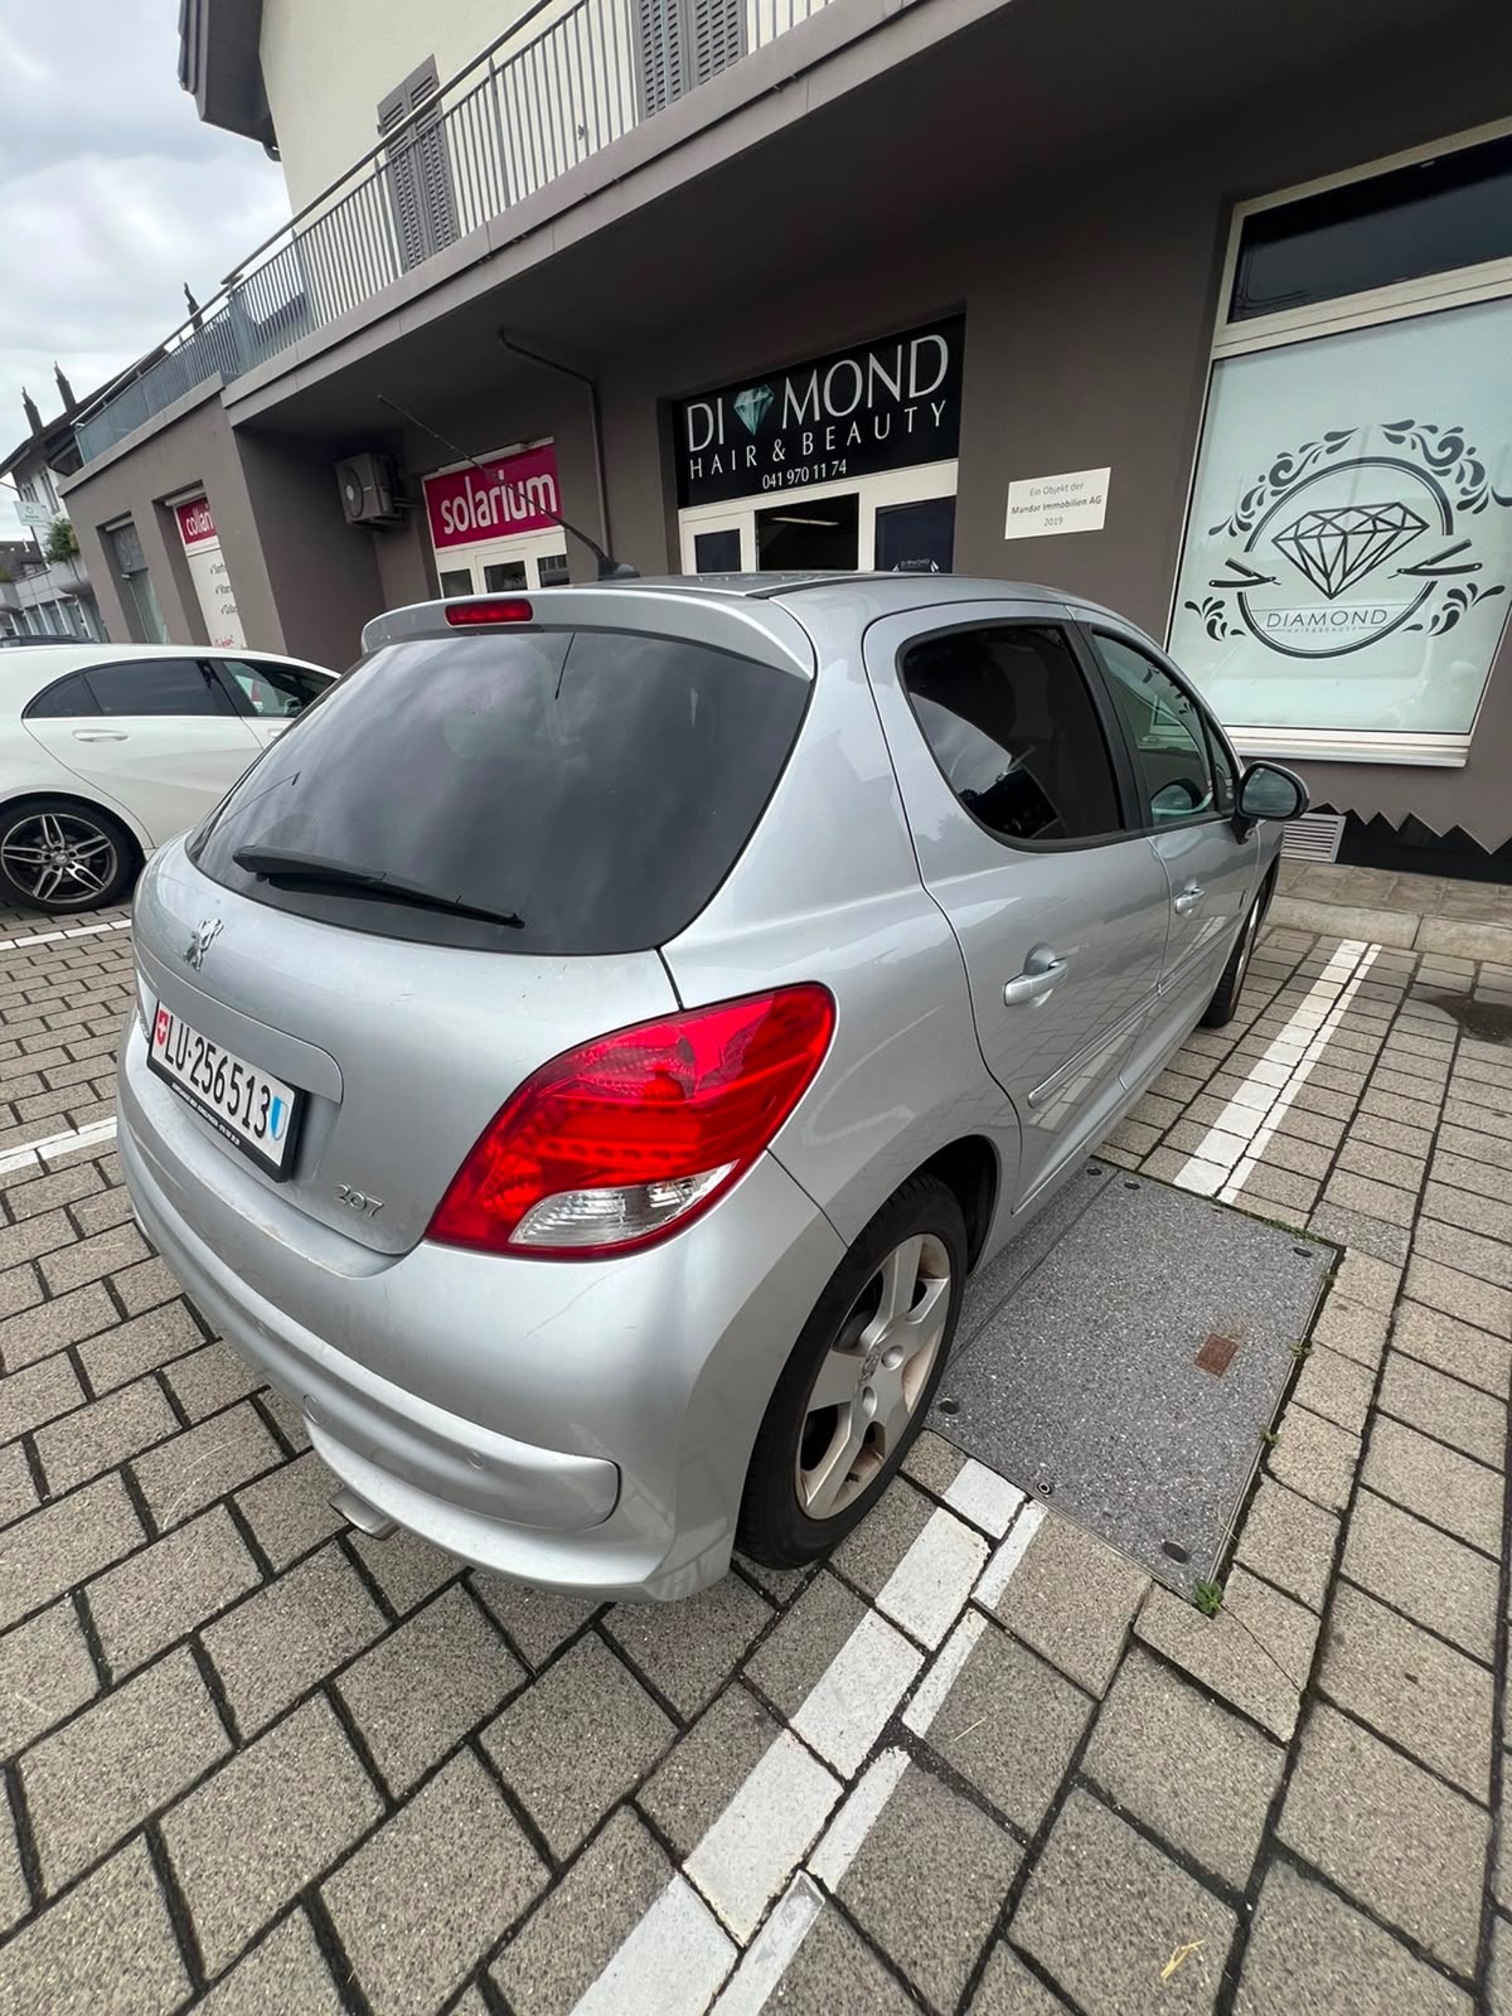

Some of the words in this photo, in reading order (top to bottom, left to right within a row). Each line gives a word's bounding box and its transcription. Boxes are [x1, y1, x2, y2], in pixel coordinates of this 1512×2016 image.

[689, 445, 758, 480] HAIR
[771, 438, 786, 462] &
[802, 399, 947, 456] BEAUTY
[762, 471, 783, 490] 041
[786, 465, 810, 485] 970
[812, 463, 827, 480] 11
[831, 458, 847, 475] 74
[441, 469, 557, 534] solarium
[1029, 487, 1042, 498] Ein
[1042, 483, 1069, 497] Objekt
[1070, 482, 1084, 492] der
[1042, 499, 1087, 511] Immobilien
[1089, 495, 1102, 505] AG
[1043, 516, 1064, 527] 2019
[1266, 609, 1388, 628] DIAMOND
[334, 1182, 385, 1218] 207
